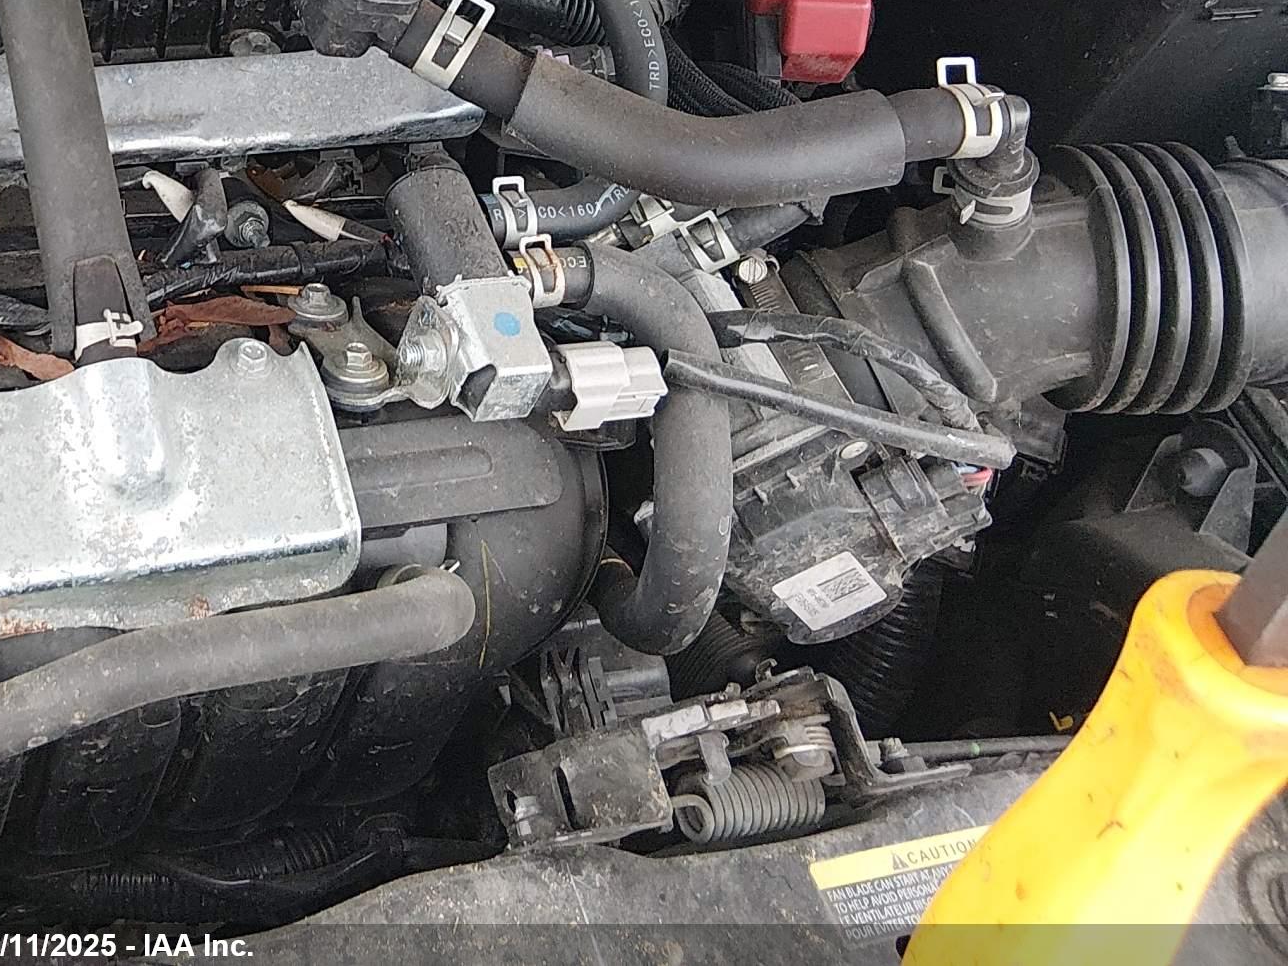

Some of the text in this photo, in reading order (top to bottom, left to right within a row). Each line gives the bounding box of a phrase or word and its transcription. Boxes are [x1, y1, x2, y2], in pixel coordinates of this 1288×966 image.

[907, 838, 977, 864] CAUTION
[827, 889, 847, 902] FAN
[845, 881, 874, 900] BLADE
[874, 878, 894, 893] CAN
[894, 871, 921, 889] START
[834, 903, 848, 916] TO
[848, 896, 872, 912] HELP
[870, 889, 898, 909] AVOID
[851, 901, 914, 925] VENTILATEUR
